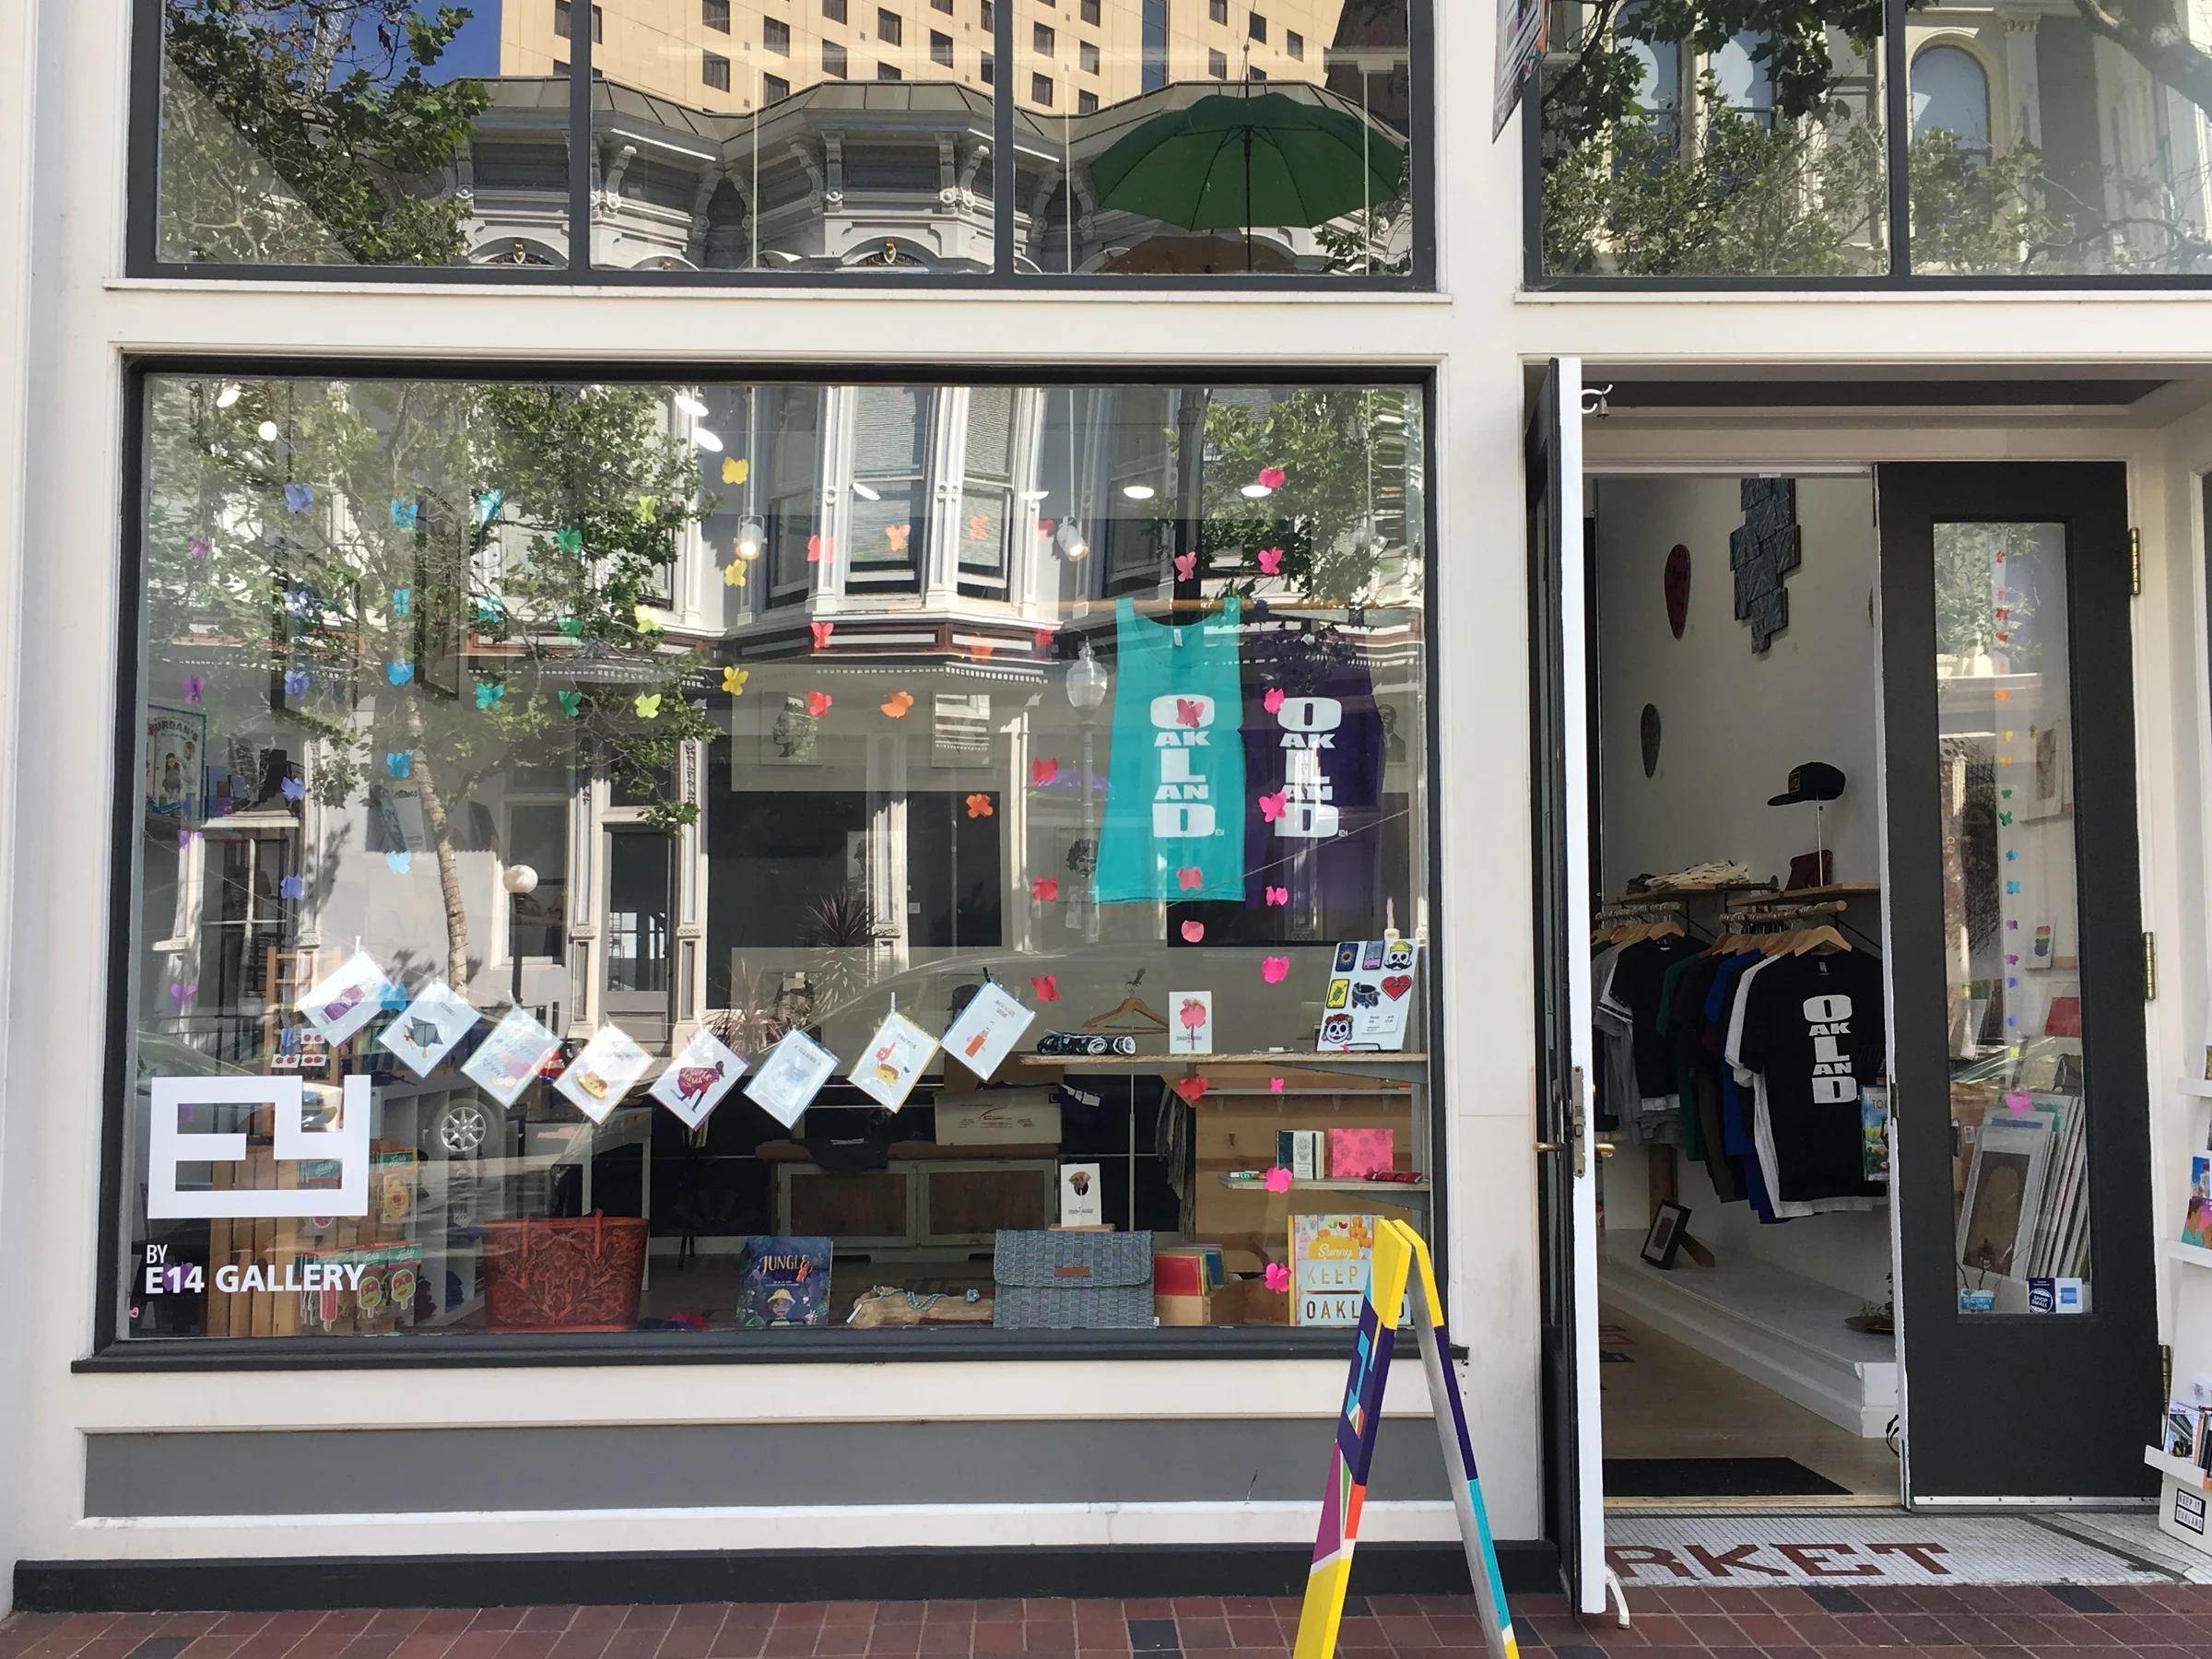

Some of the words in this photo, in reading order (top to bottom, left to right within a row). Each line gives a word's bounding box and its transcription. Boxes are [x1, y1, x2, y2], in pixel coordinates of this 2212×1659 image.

[147, 1244, 168, 1264] BY
[1318, 1243, 1353, 1261] Sunny
[145, 1266, 205, 1294] E14
[216, 1264, 366, 1293] GALLERY
[1307, 1265, 1359, 1285] KEEP
[2031, 1300, 2048, 1309] SMALL
[2033, 1295, 2048, 1303] SHOP
[2179, 1494, 2193, 1507] KEEP
